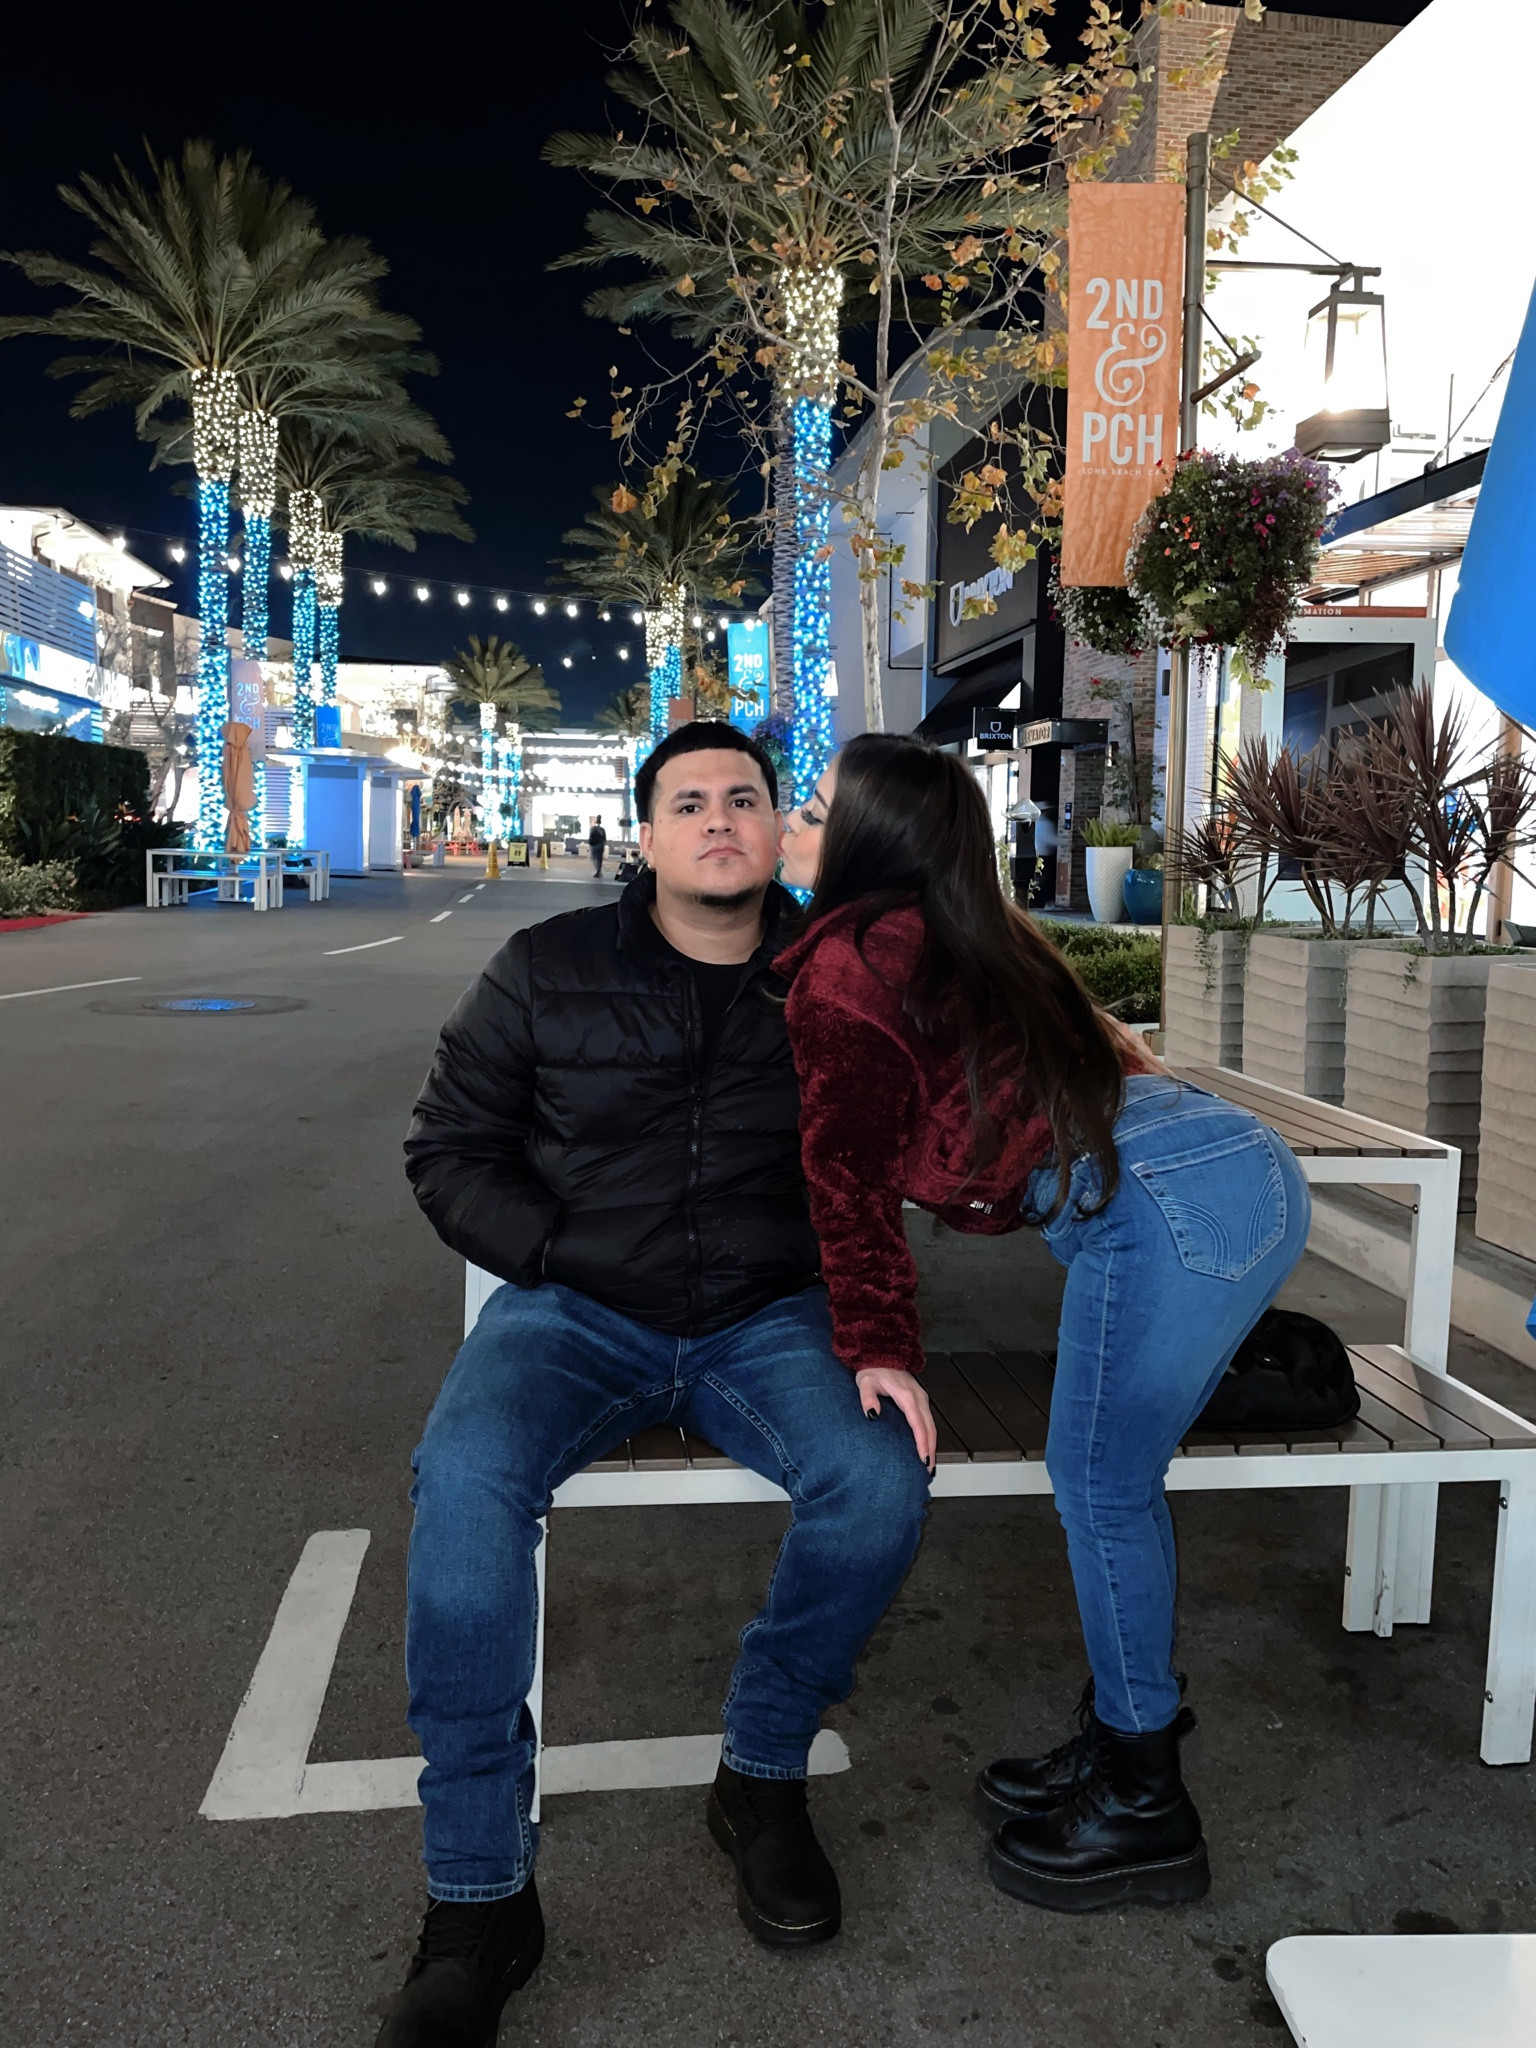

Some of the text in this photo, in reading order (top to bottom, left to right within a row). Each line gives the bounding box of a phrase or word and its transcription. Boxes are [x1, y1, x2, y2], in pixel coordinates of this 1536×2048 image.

[1086, 277, 1163, 329] 2ND
[1095, 322, 1167, 406] &
[1082, 411, 1163, 465] PCH
[733, 653, 763, 672] 2ND
[237, 682, 259, 696] 2ND
[735, 698, 764, 717] PCH
[979, 732, 1012, 740] BRIXTON
